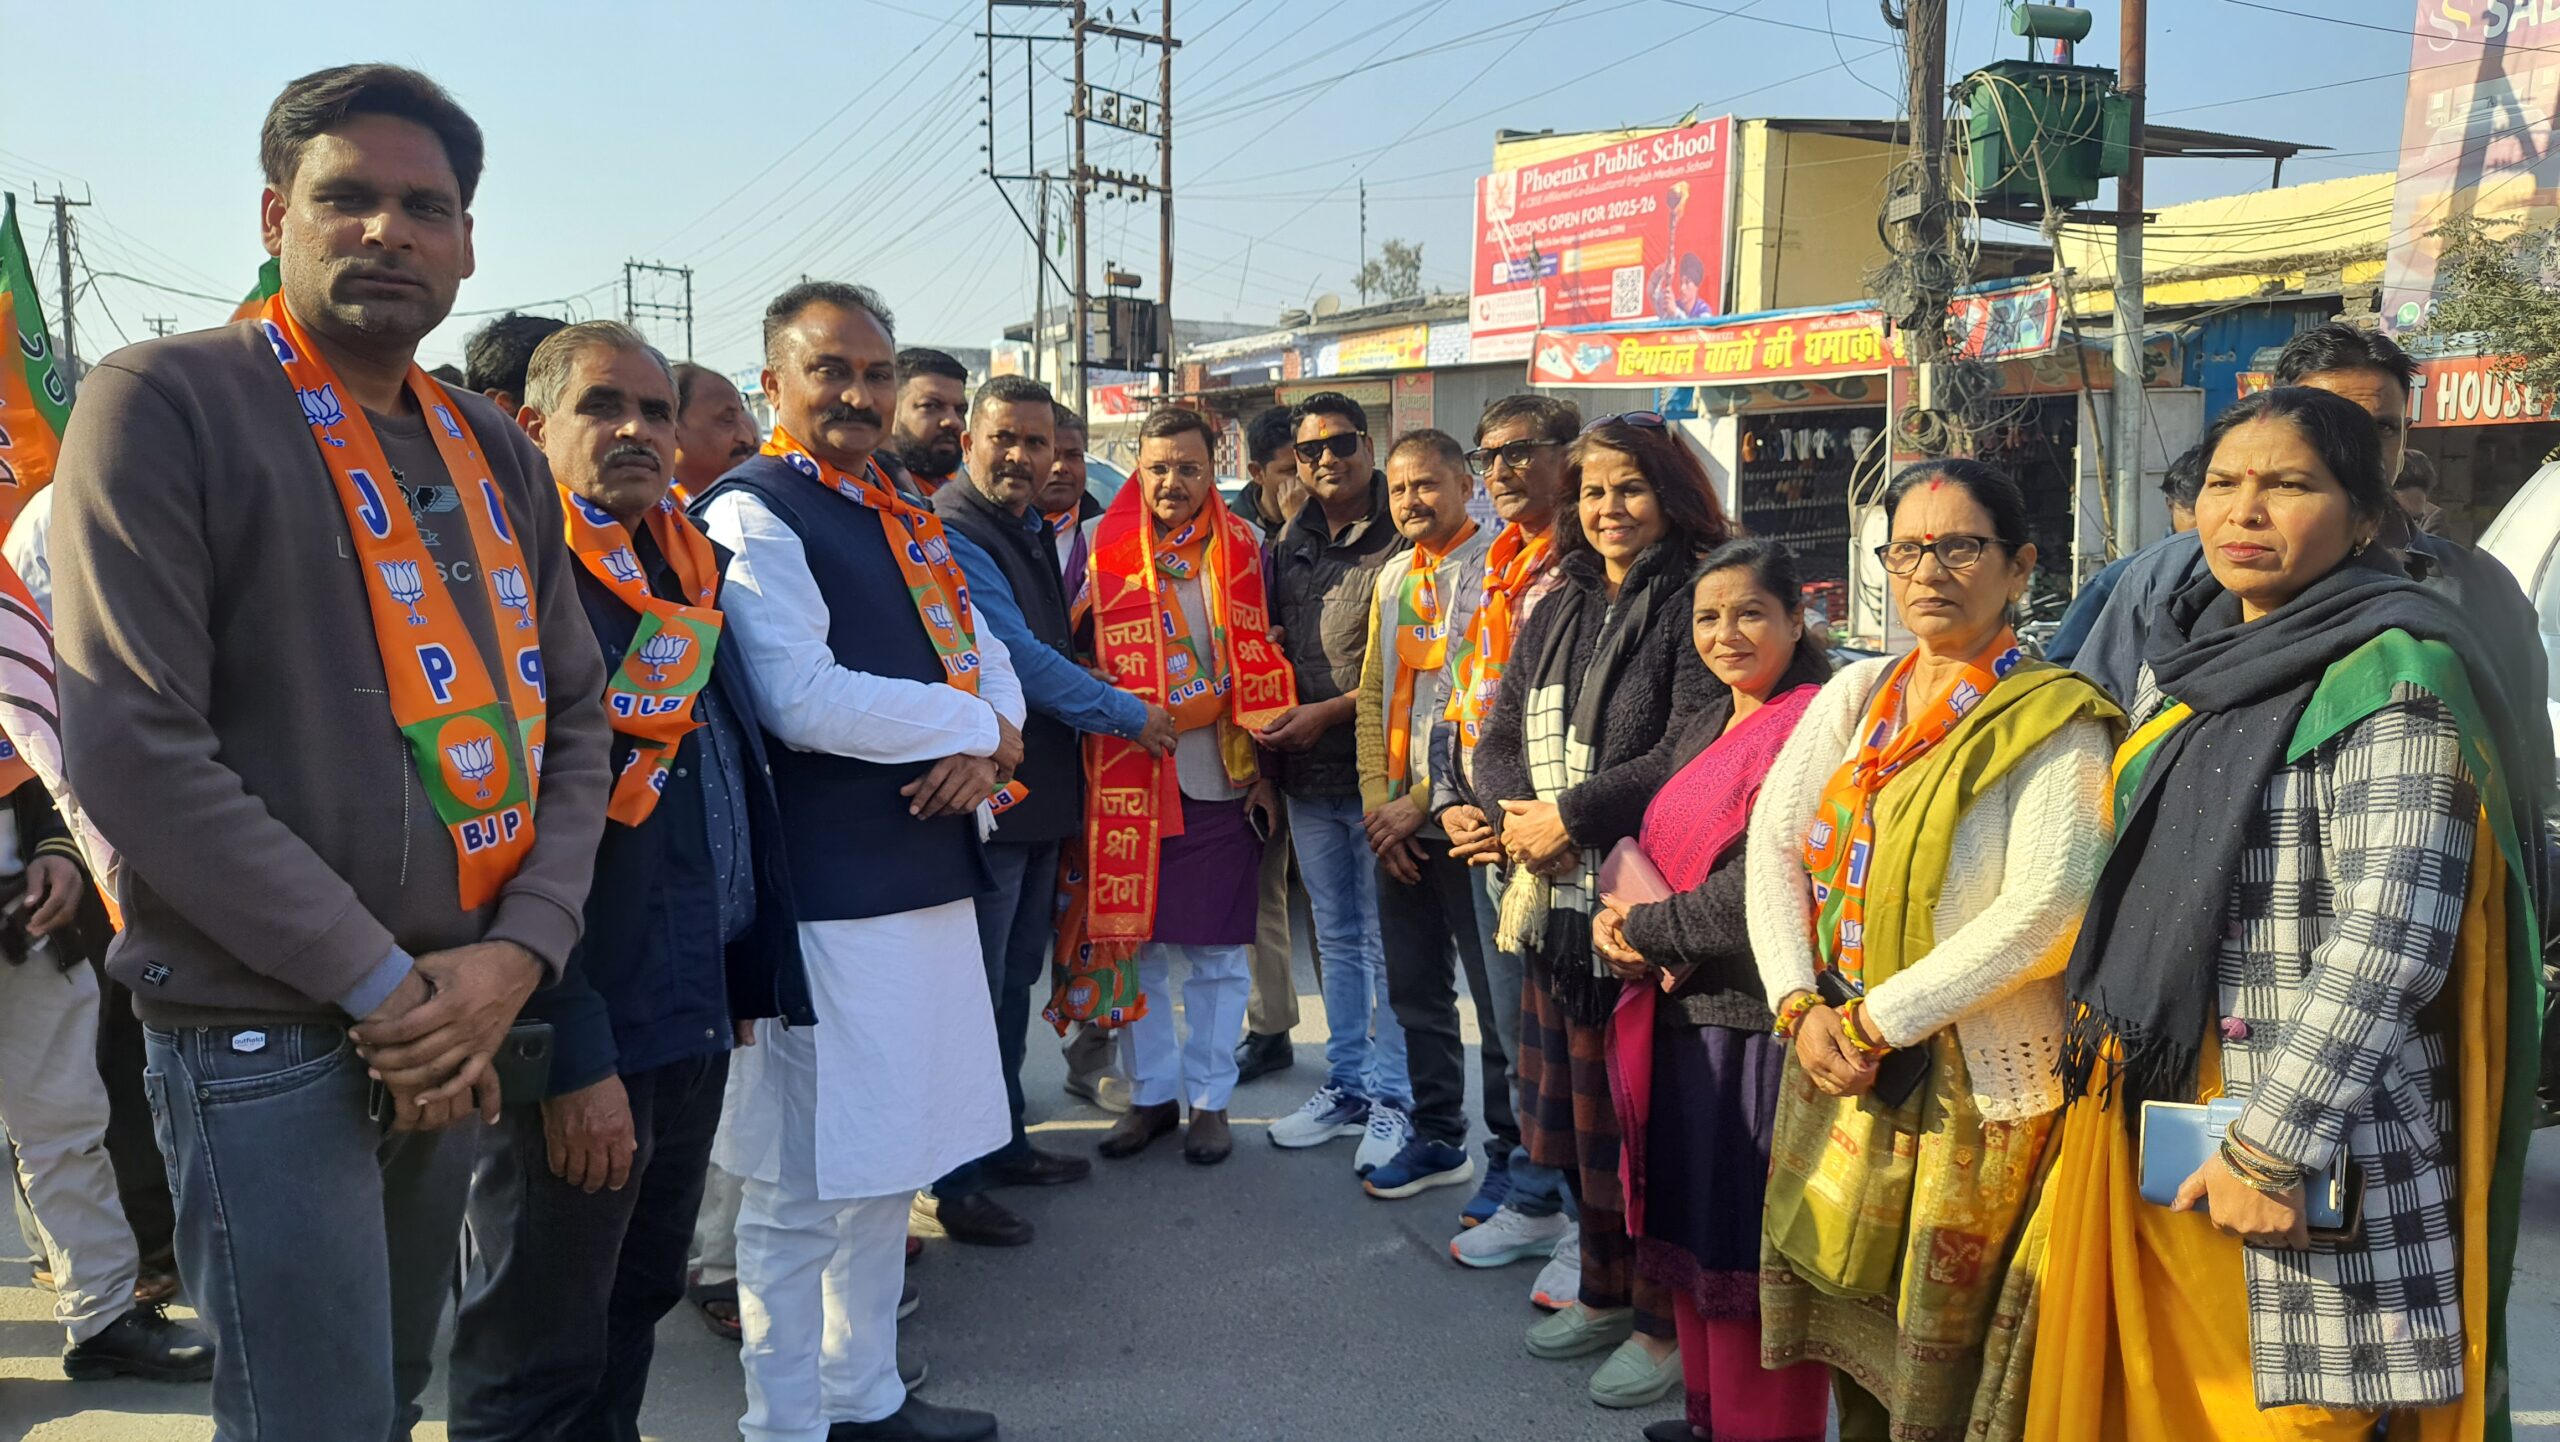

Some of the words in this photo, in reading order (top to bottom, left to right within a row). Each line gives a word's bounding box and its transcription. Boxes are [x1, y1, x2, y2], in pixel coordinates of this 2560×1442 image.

[1521, 159, 1589, 195] Phoenix
[1592, 144, 1648, 179] Public
[1652, 124, 1716, 164] School
[1548, 211, 1580, 232] OPEN
[1581, 205, 1606, 225] FOR
[1607, 195, 1657, 220] 2025-26
[1704, 327, 1760, 374] वालों
[1763, 326, 1798, 370] की
[1104, 618, 1154, 647] जय
[1231, 600, 1263, 633] जय
[1114, 651, 1148, 678] श्री
[1237, 639, 1269, 664] श्री
[1242, 669, 1286, 703] राम
[1100, 787, 1152, 817] जय
[458, 809, 521, 855] BJP
[1103, 826, 1141, 861] श्री
[1097, 873, 1145, 907] राम
